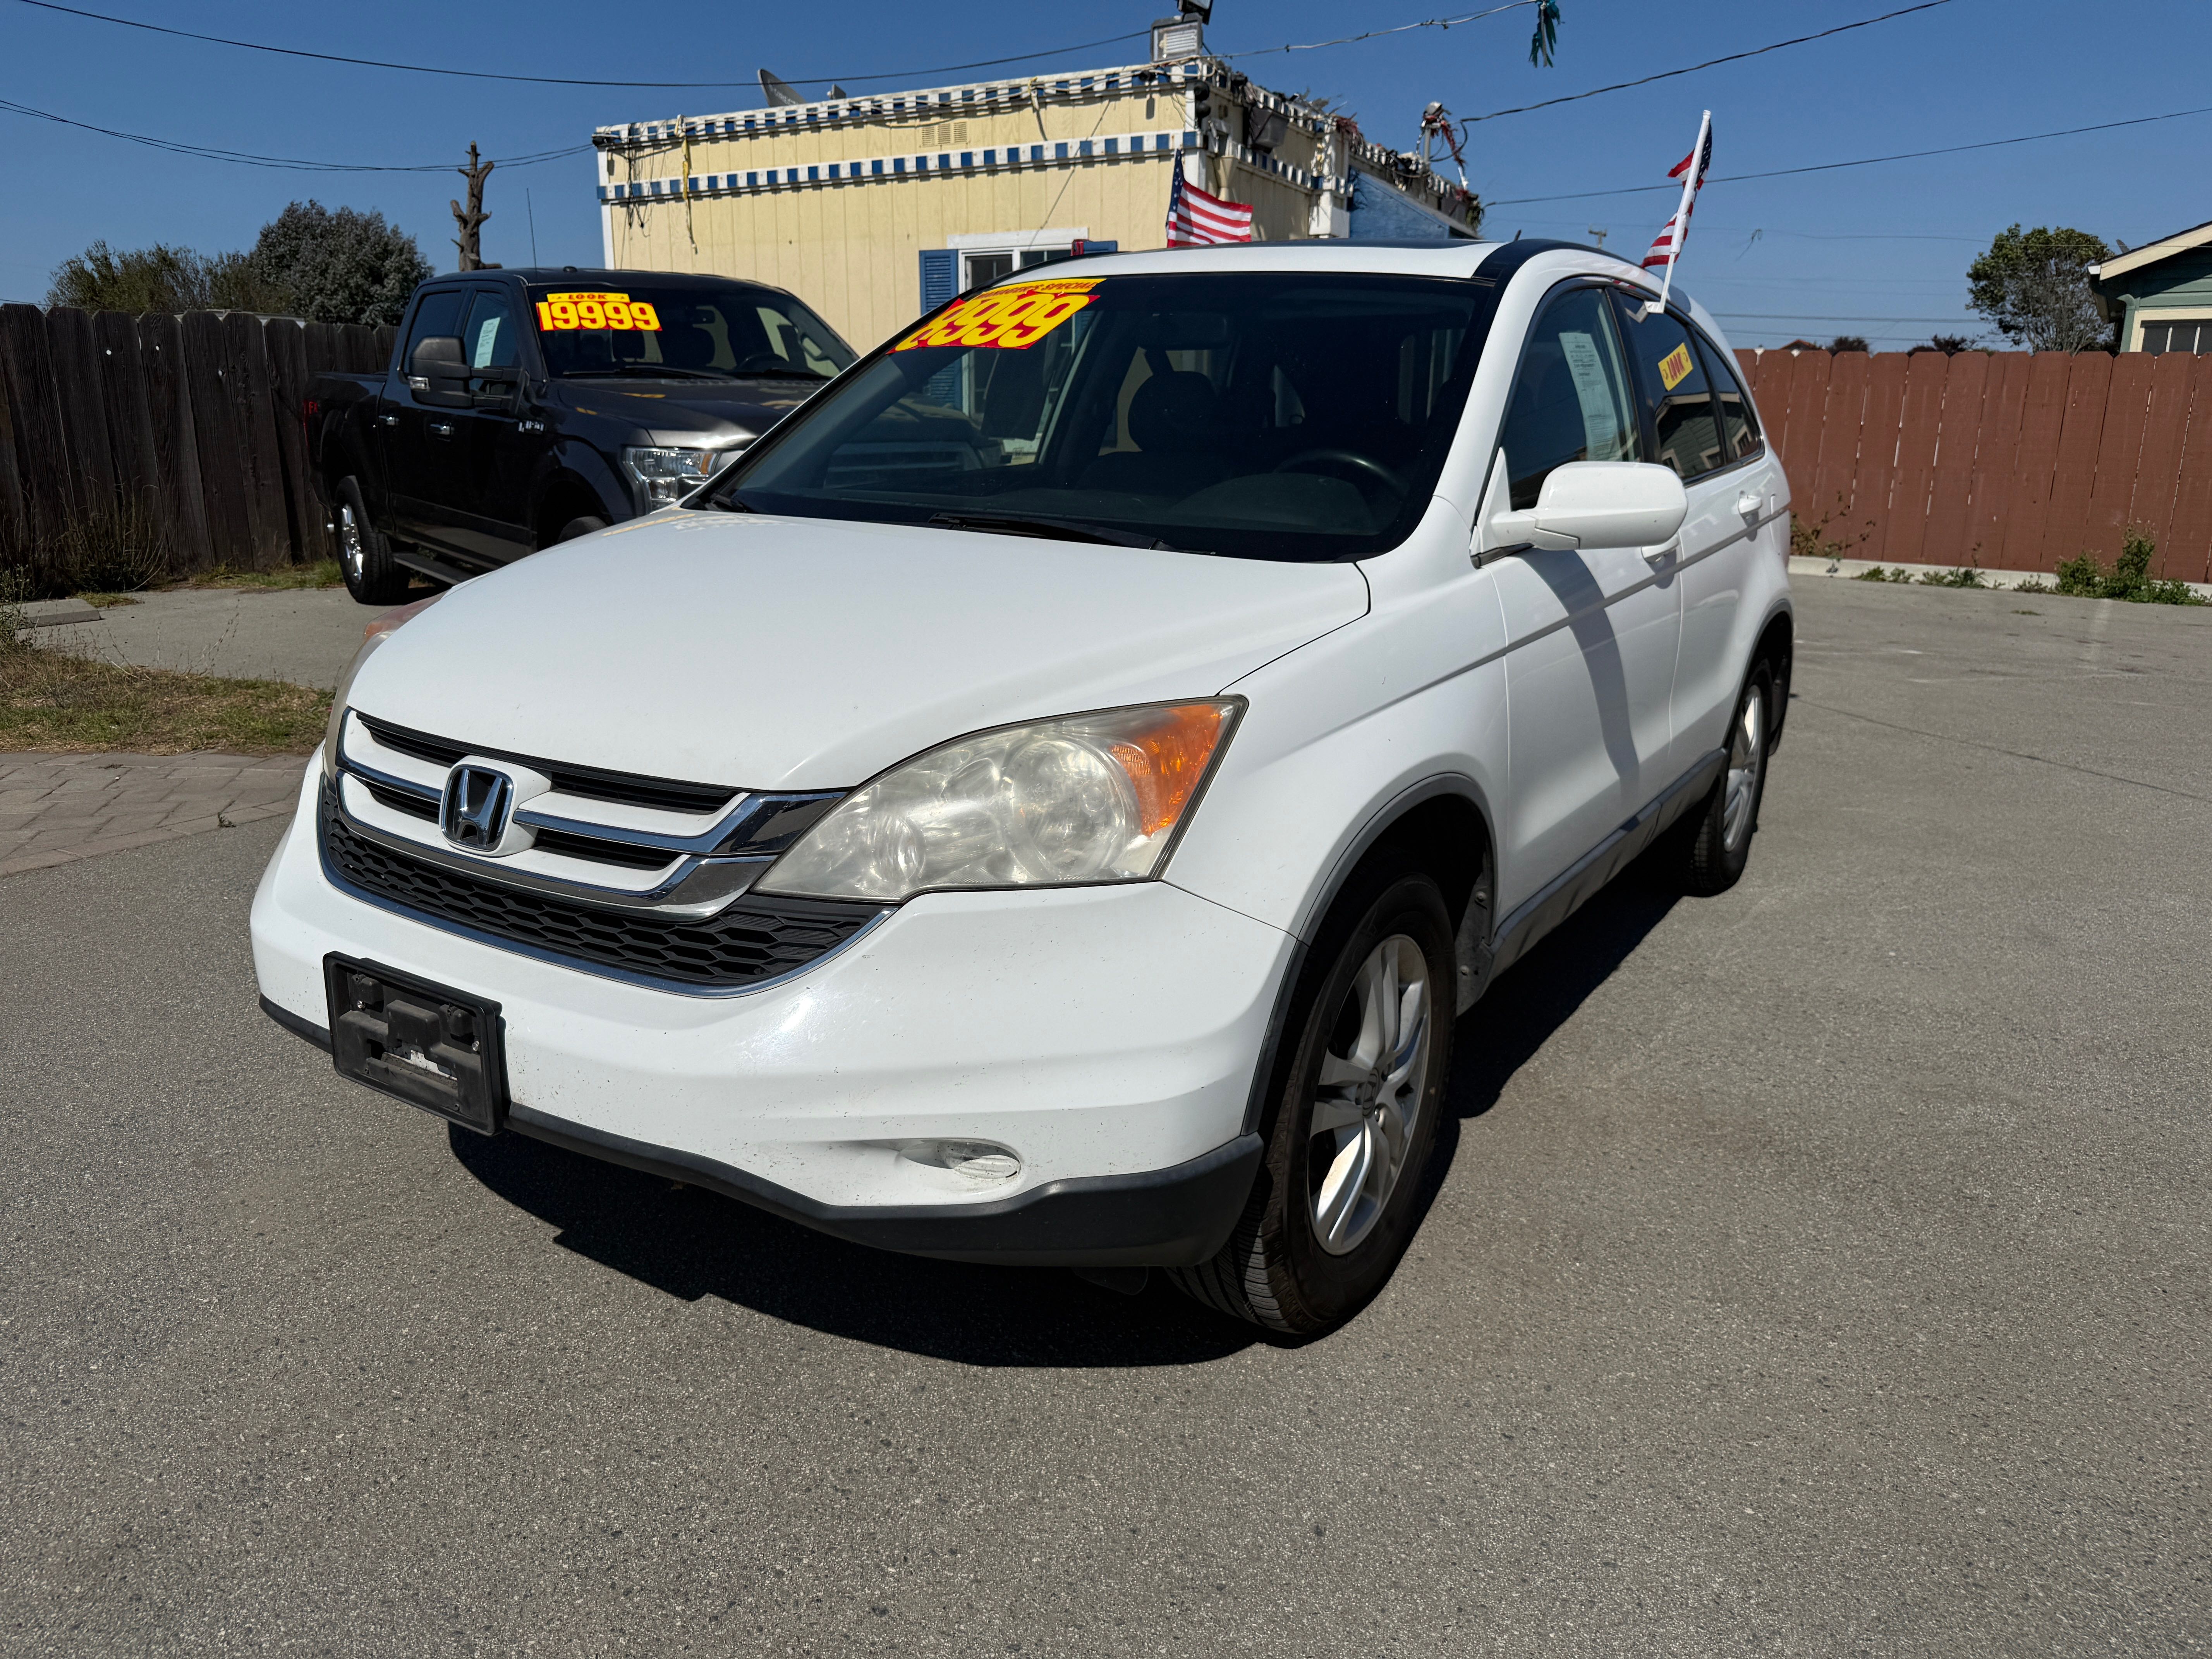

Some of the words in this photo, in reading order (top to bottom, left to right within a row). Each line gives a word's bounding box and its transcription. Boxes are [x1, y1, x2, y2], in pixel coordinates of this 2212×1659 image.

[1041, 282, 1098, 292] SPECIAL
[538, 302, 660, 330] 19999
[1666, 352, 1685, 381] LOOK
